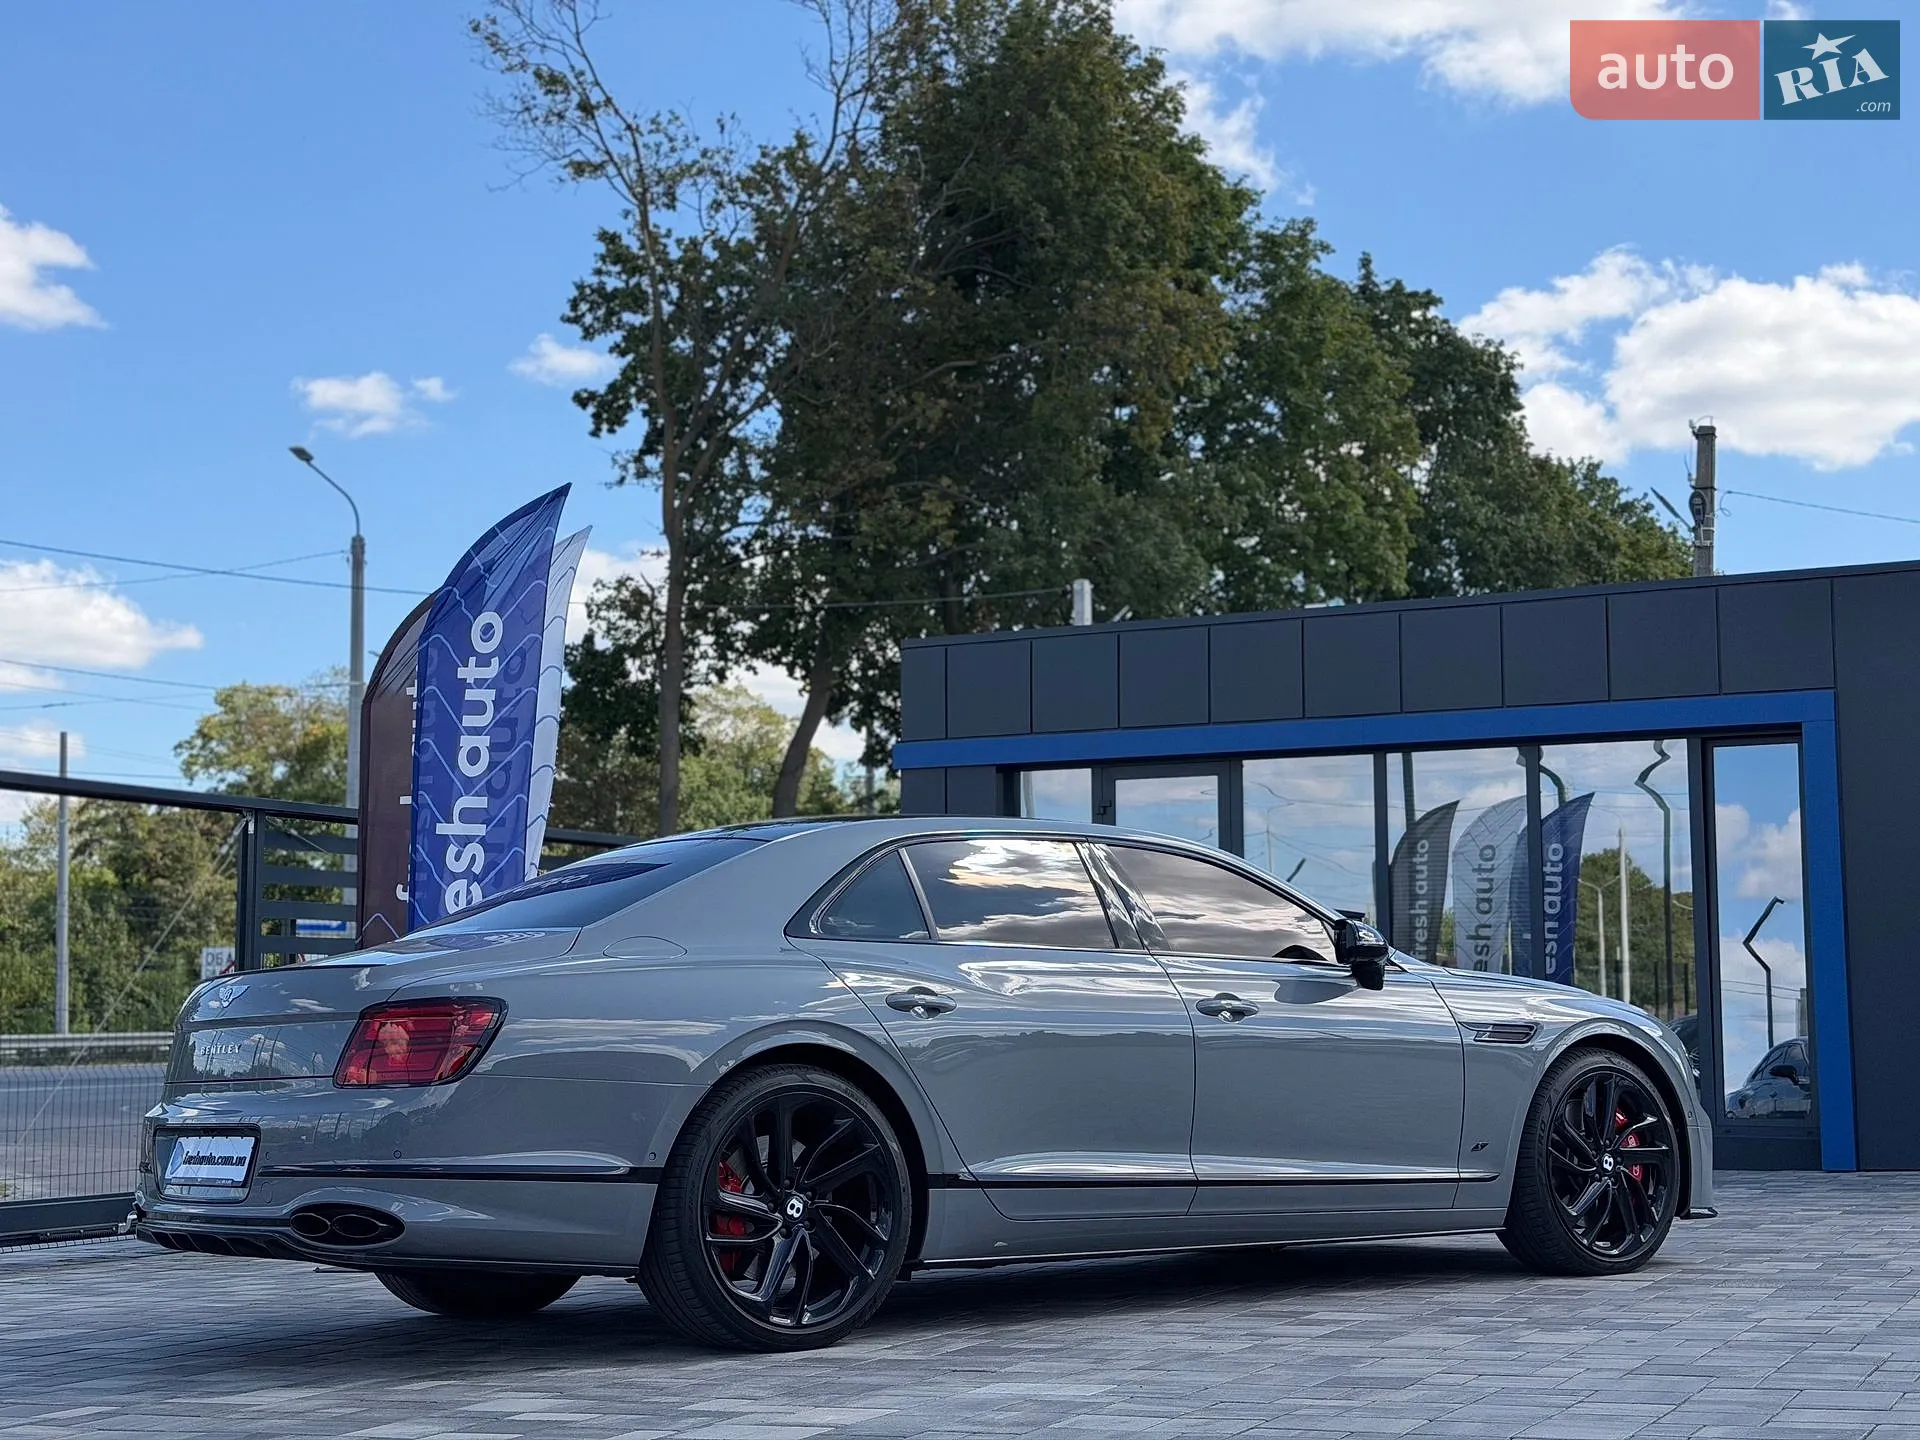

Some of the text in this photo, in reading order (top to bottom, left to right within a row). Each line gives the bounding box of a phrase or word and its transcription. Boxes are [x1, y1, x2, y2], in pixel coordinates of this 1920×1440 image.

[457, 611, 503, 777] auto
[1412, 839, 1429, 895] auto
[1472, 844, 1496, 915] auto
[1543, 843, 1564, 915] auto
[200, 1044, 242, 1055] BENTLEY
